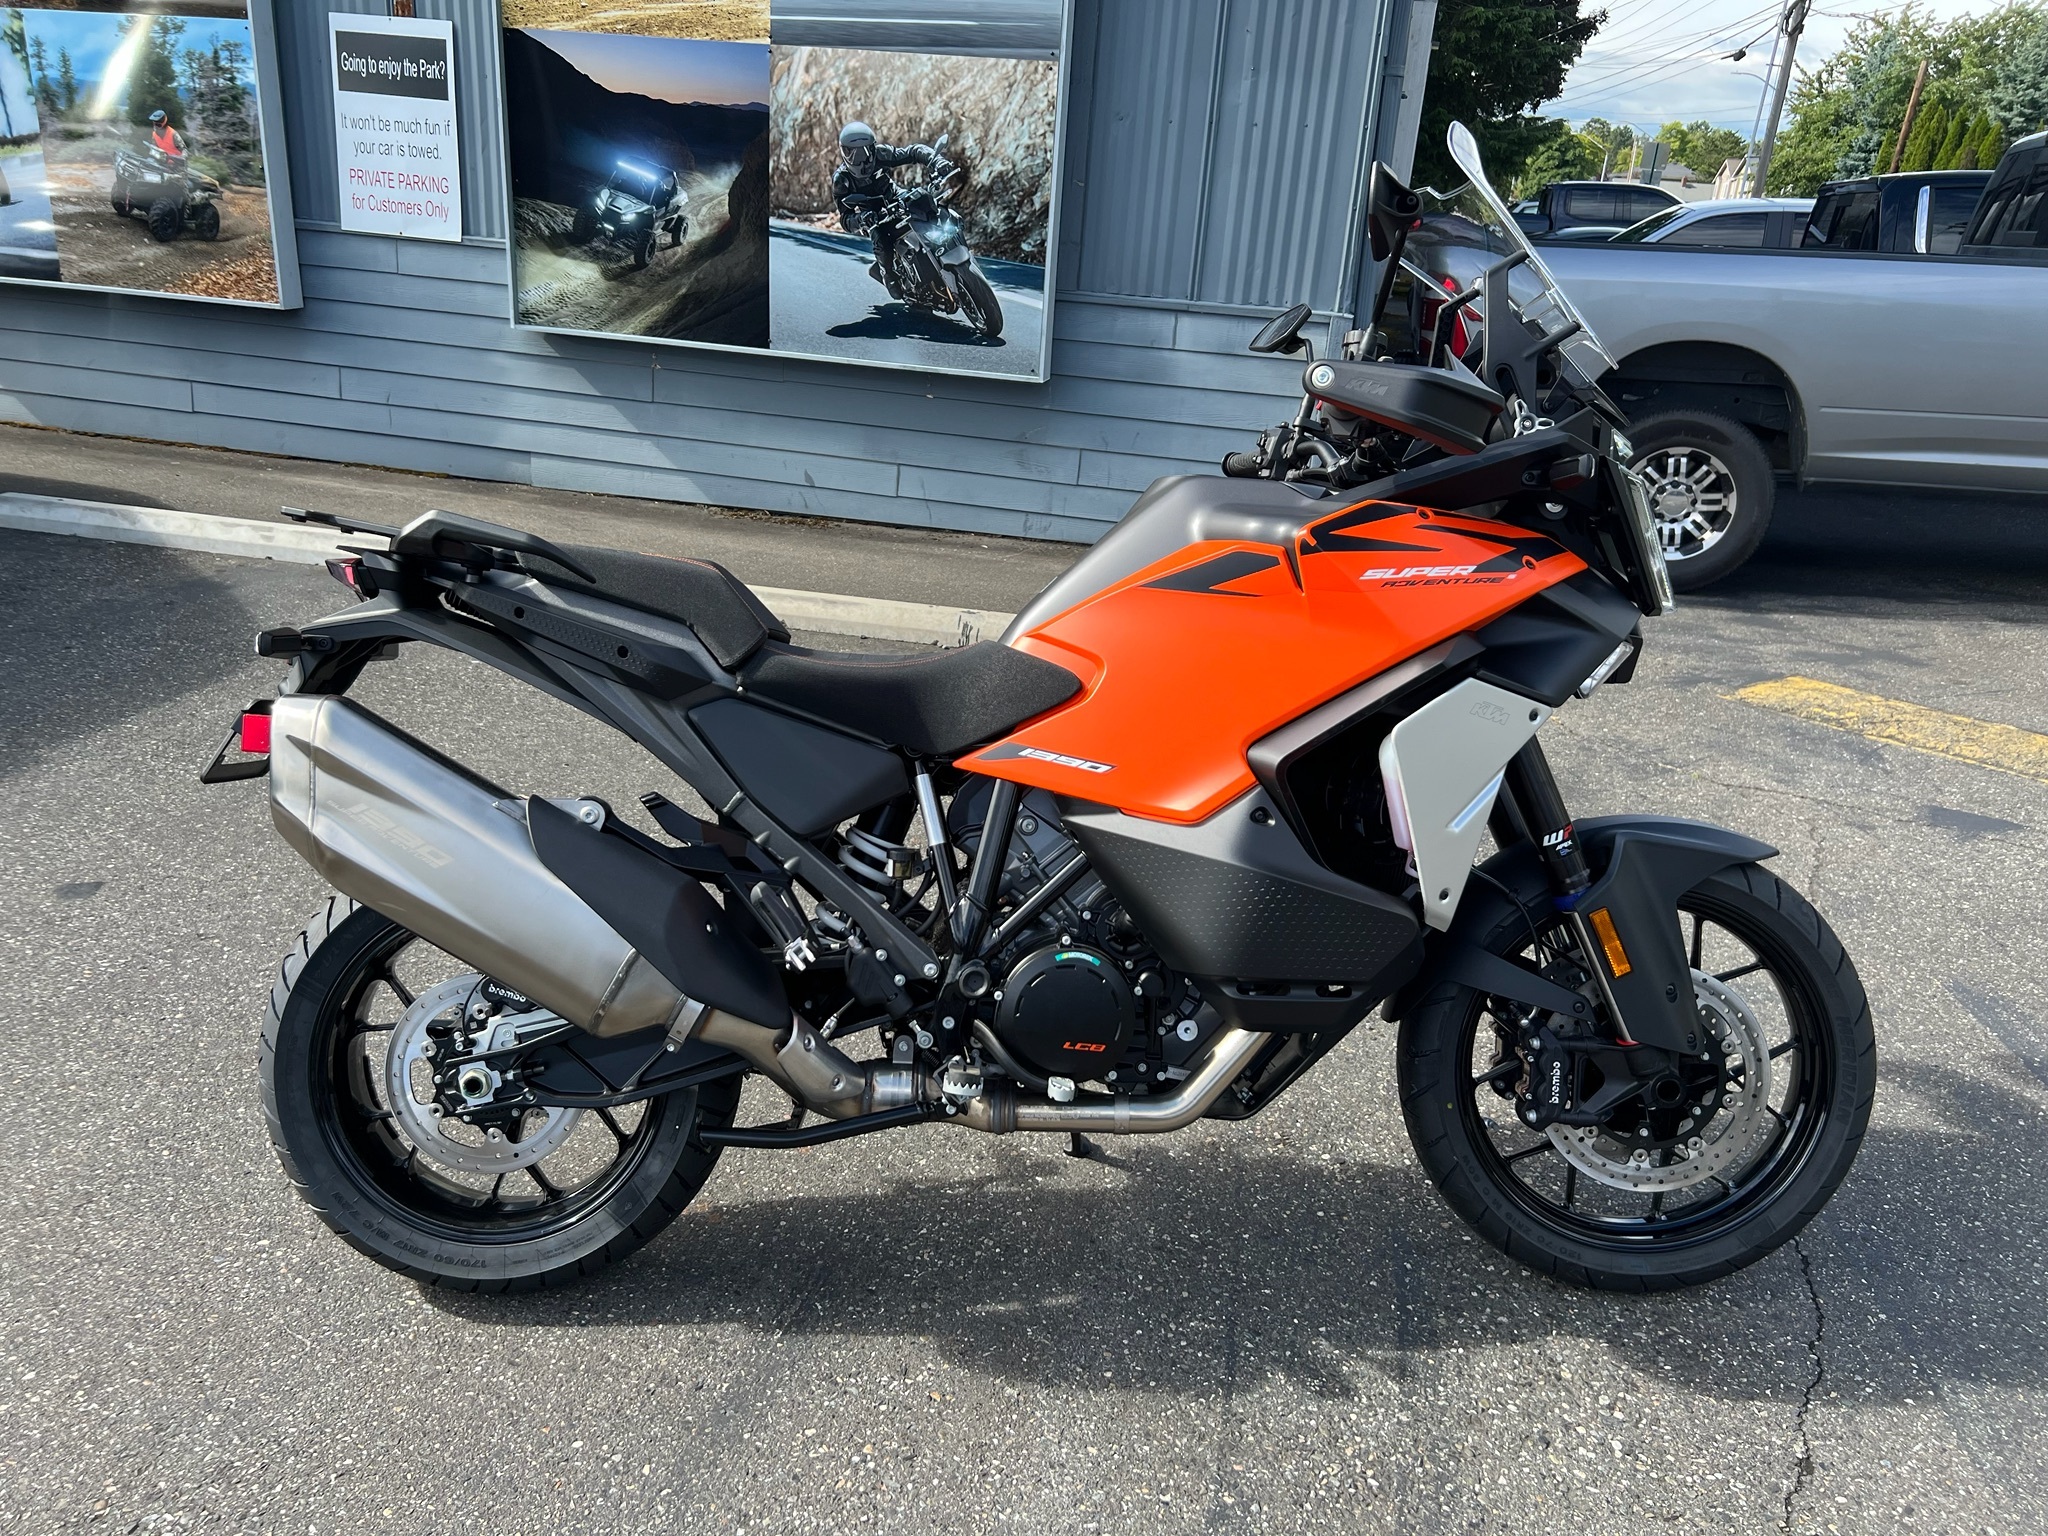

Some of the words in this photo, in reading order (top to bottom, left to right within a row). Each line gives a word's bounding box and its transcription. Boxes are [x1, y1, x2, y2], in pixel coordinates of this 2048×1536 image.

[341, 52, 366, 78] Going
[368, 56, 377, 74] to
[378, 57, 402, 81] enjoy
[403, 58, 418, 78] the
[419, 59, 446, 80] Park?
[341, 113, 348, 130] It
[349, 115, 377, 132] won't
[378, 115, 391, 132] be
[394, 118, 422, 135] much
[425, 118, 441, 136] fun
[443, 120, 451, 137] if
[353, 141, 376, 158] your
[378, 143, 394, 157] car
[396, 141, 405, 157] is
[408, 143, 442, 160] towed.
[349, 168, 395, 189] PRIVATE
[398, 173, 450, 194] PARKING
[352, 193, 365, 210] for
[368, 195, 423, 217] Customers
[425, 200, 450, 223] Only
[1345, 377, 1389, 396] KTM
[1359, 565, 1478, 580] SUPER
[1381, 576, 1505, 588] ADVENTURE
[1469, 700, 1511, 726] KTM
[1018, 748, 1114, 773] 1390
[1543, 824, 1573, 847] WP
[488, 983, 527, 1003] brembo
[1063, 1041, 1107, 1052] LC8
[1836, 1015, 1857, 1125] MERIDIAN
[1549, 1061, 1561, 1104] brembo
